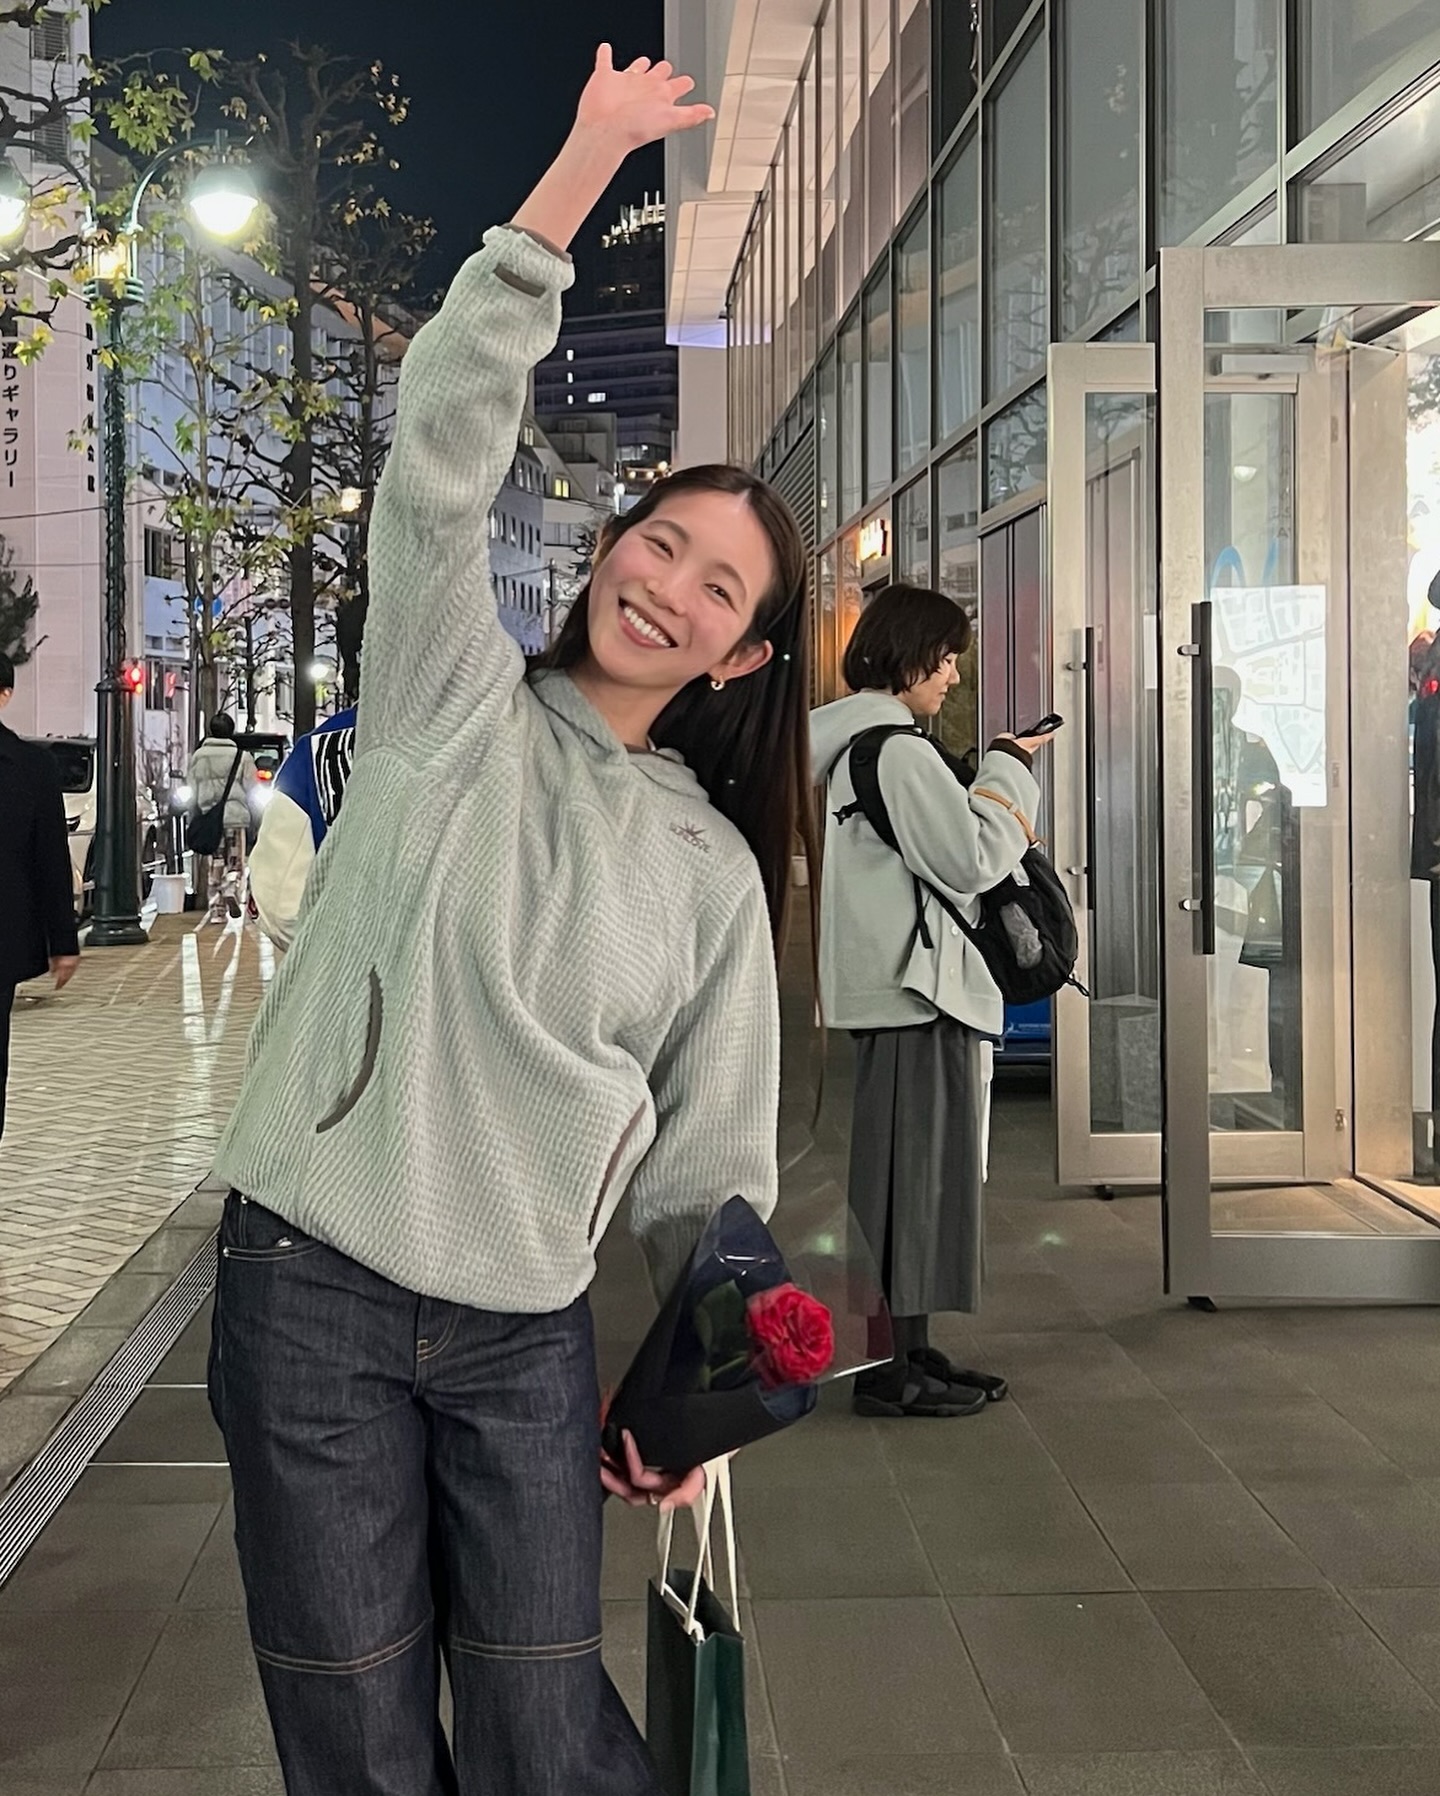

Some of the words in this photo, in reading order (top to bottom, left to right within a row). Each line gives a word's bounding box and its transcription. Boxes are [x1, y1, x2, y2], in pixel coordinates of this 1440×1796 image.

[2, 280, 19, 487] 通りギャラリー
